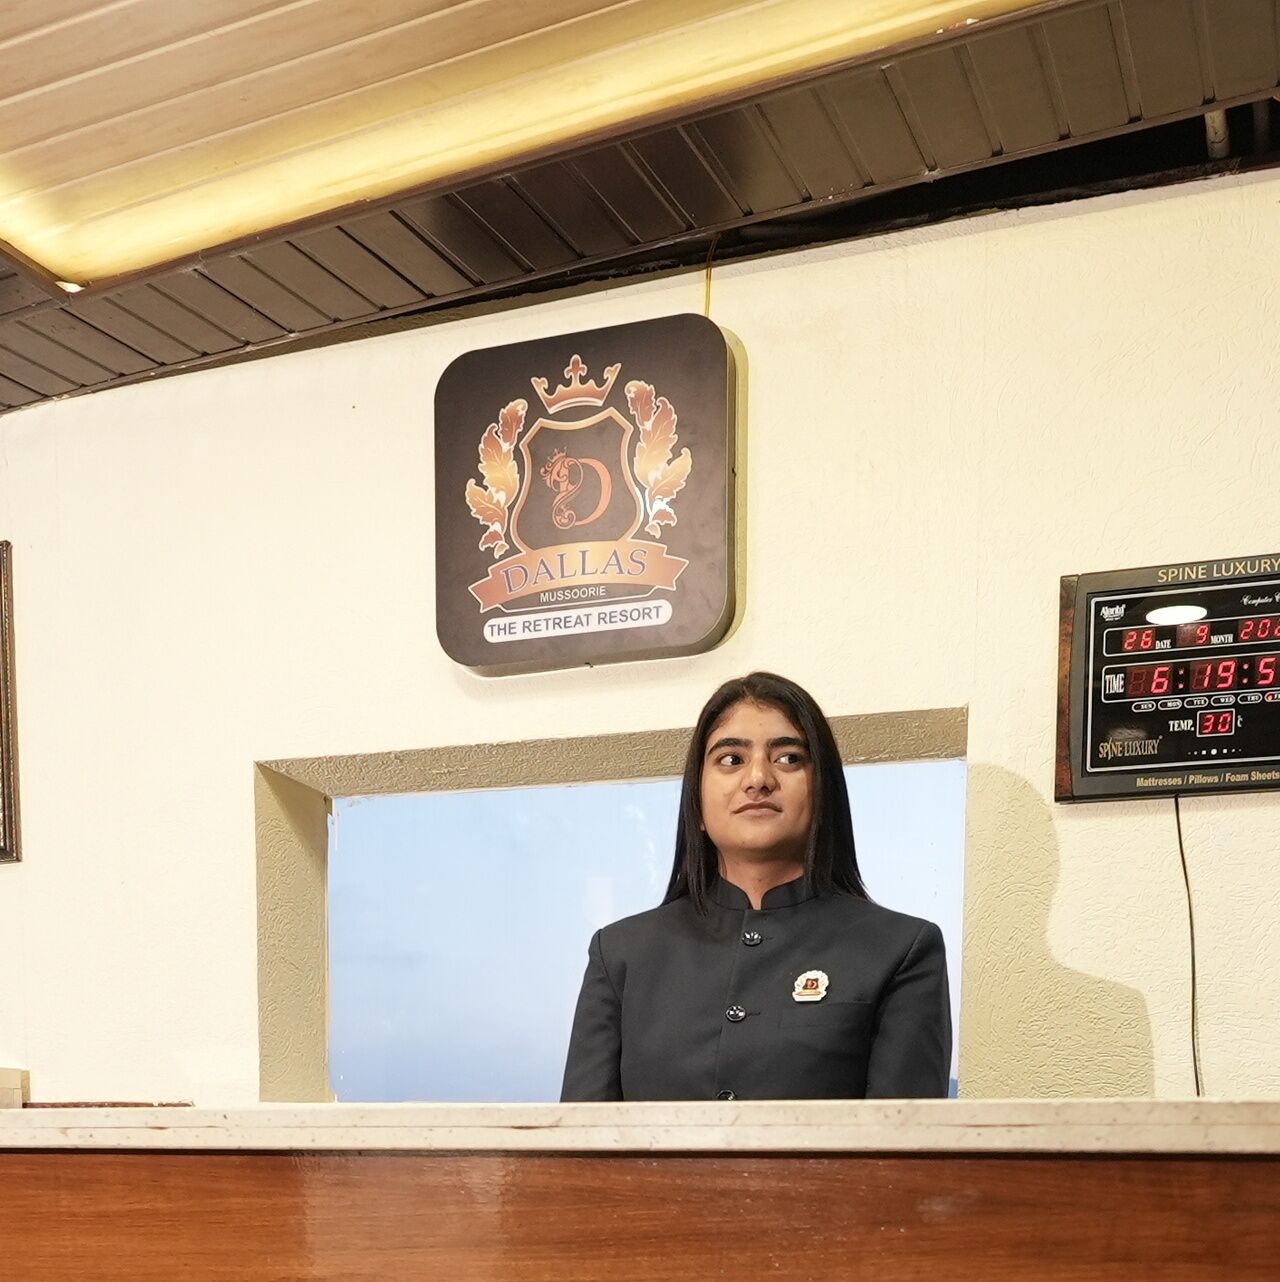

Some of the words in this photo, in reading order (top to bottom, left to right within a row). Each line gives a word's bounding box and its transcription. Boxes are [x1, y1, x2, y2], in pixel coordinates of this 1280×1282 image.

[502, 549, 648, 595] DALLAS
[1157, 565, 1207, 582] SPINE
[540, 585, 606, 603] MUSSOORIE
[489, 622, 517, 638] THE
[522, 614, 593, 635] RETREAT
[597, 606, 663, 625] RESORT
[1155, 639, 1172, 650] DATE
[1196, 625, 1209, 644] 9
[1211, 634, 1234, 644] MONTH
[1105, 674, 1125, 694] TIME
[1168, 719, 1195, 732] TEMP.
[1202, 712, 1232, 733] 30
[1099, 737, 1123, 760] SPINE
[1136, 775, 1182, 787] Mattresses
[1188, 773, 1218, 785] Pillows
[1225, 772, 1249, 782] Foam
[1251, 770, 1280, 781] Sheets
